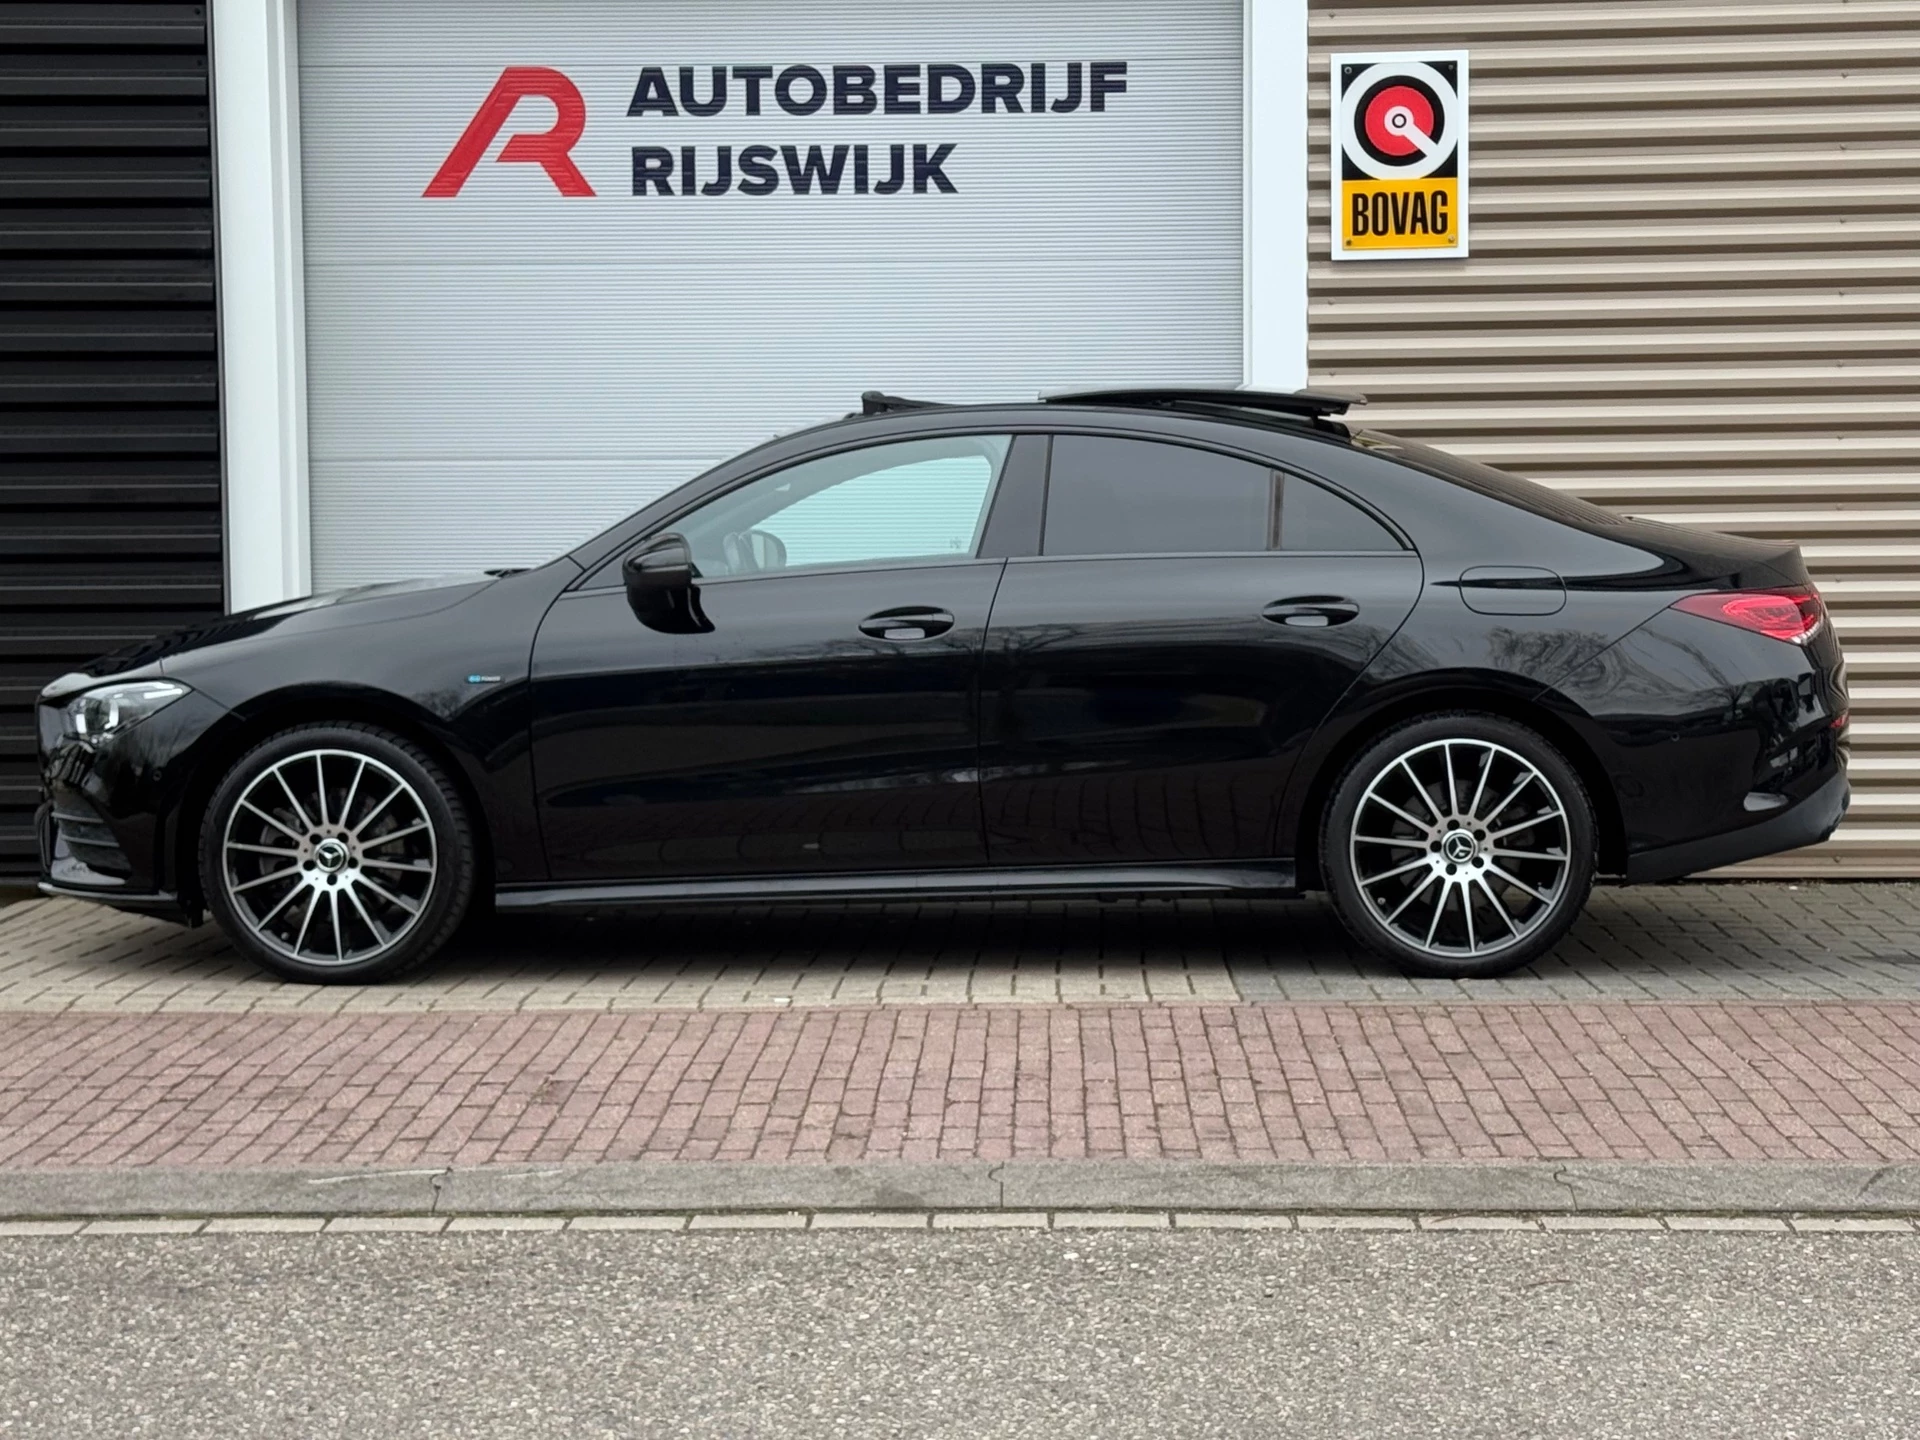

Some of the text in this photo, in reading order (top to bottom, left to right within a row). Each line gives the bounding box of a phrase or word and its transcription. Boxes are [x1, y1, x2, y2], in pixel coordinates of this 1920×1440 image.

[626, 61, 1128, 117] AUTOBEDRIJF
[631, 143, 958, 197] RIJSWIJK
[1352, 190, 1448, 236] BOVAG
